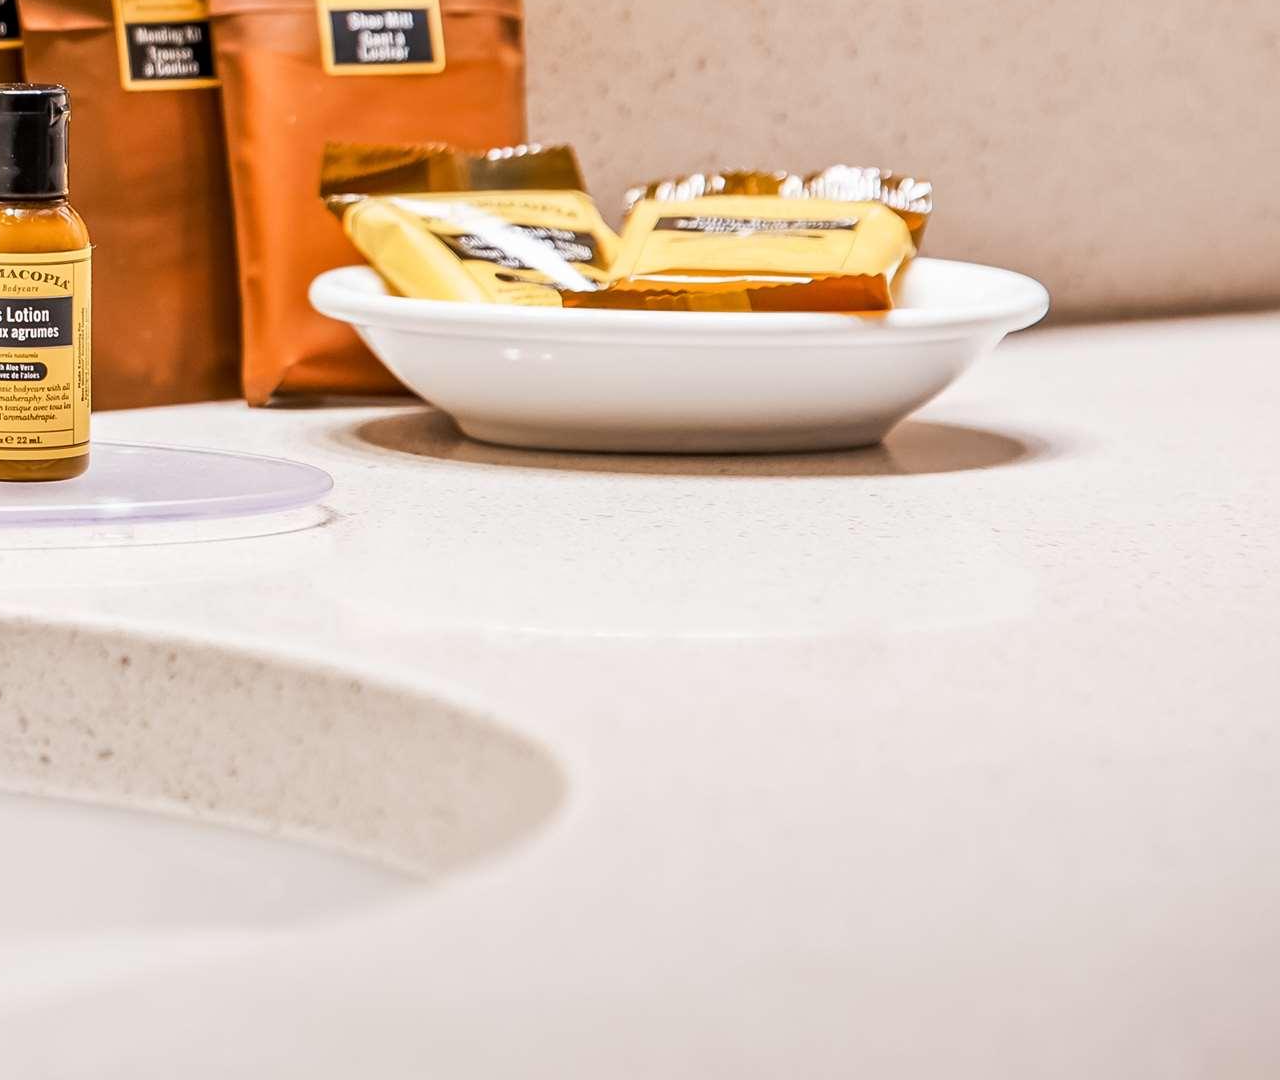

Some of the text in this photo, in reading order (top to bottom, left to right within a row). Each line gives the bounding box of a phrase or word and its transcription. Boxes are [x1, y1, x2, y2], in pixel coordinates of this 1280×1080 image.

[7, 306, 50, 323] Lotion
[11, 326, 59, 341] agrumes
[17, 436, 27, 444] 22
